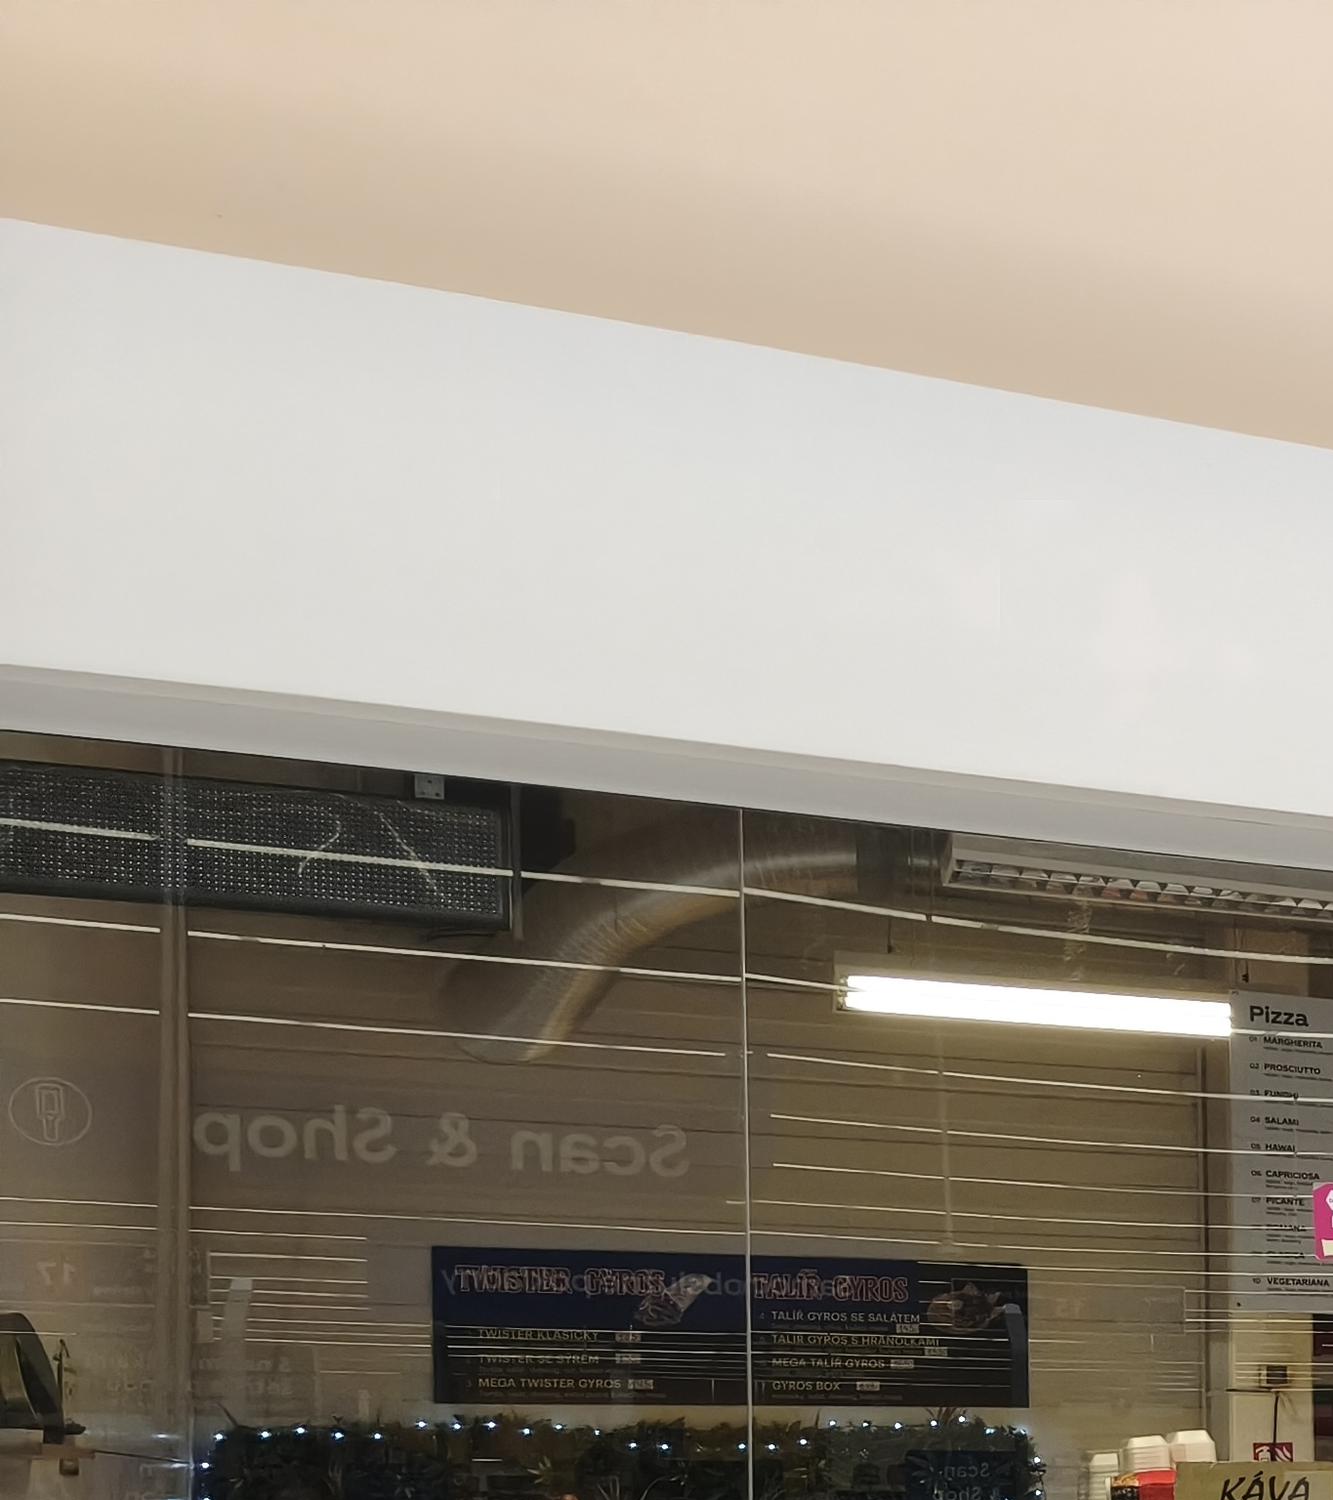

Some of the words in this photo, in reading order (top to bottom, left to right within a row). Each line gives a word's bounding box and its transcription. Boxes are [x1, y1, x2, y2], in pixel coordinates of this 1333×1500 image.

[1250, 1006, 1309, 1026] Pizza
[1263, 1036, 1323, 1049] MARGHERITA
[1264, 1063, 1320, 1075] PROSCIUTTO
